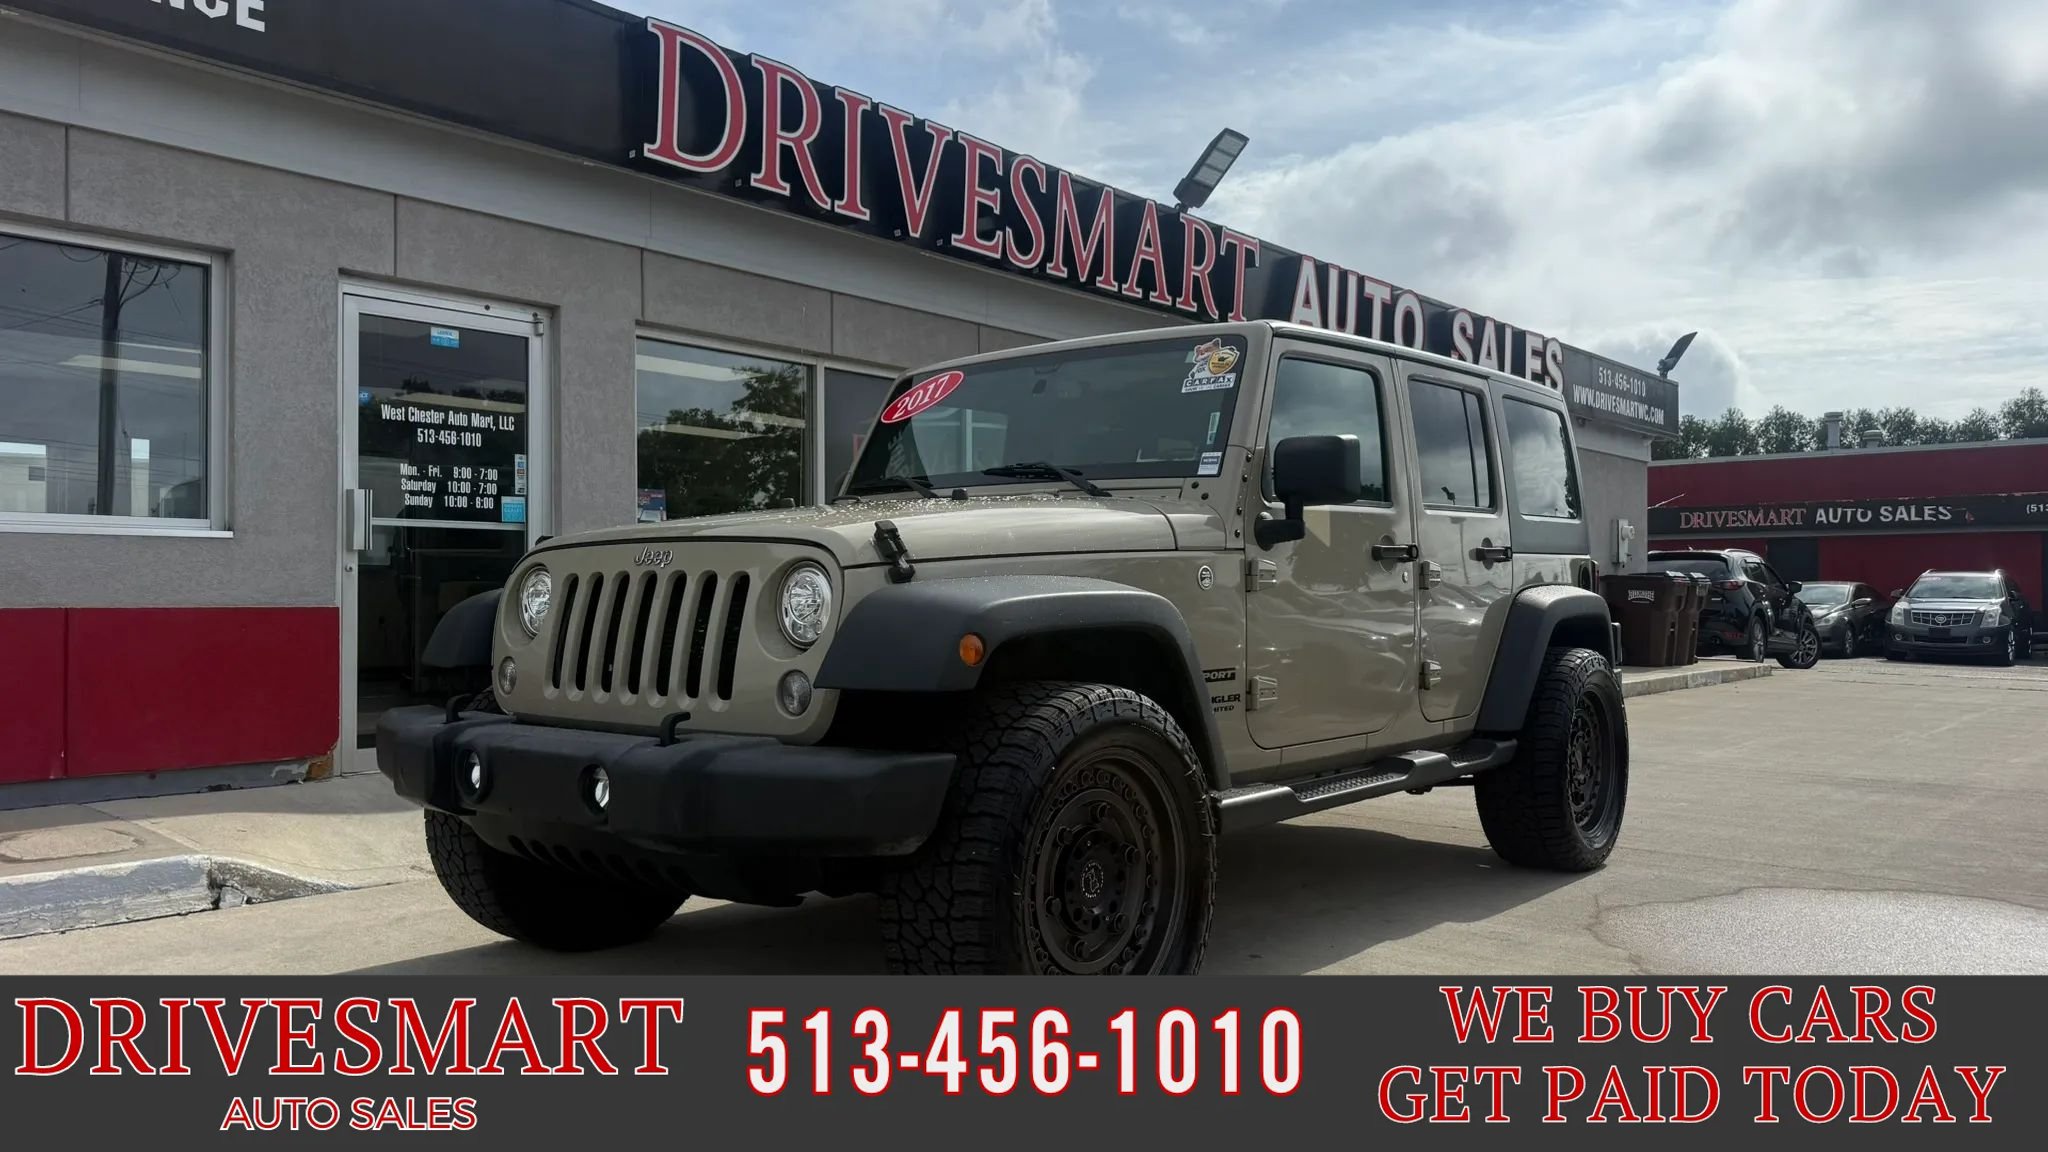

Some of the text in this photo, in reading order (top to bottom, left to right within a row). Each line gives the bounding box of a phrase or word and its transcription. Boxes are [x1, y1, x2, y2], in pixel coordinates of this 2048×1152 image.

[643, 16, 1564, 394] DRIVESMART AUTO SALES
[1185, 376, 1234, 387] CARFAX
[1598, 366, 1646, 398] 513-456-1010
[892, 374, 951, 420] 2017
[1572, 383, 1665, 425] WWW.DRIVESMARTWC.COM
[381, 403, 515, 431] West Chester Auto Mart, LLC
[417, 428, 482, 447] 513-456-1010
[400, 463, 420, 476] Mon.
[428, 464, 443, 478] Fri.
[453, 466, 472, 479] 9:00
[479, 468, 498, 481] 7:00
[401, 478, 437, 494] Saturday
[447, 480, 471, 493] 10:00
[478, 482, 498, 495] 7:00
[404, 493, 433, 508] Sunday
[444, 495, 468, 508] 10:00
[1680, 505, 1952, 529] DRIVESMART AUTO SALES
[634, 546, 673, 567] Jeep
